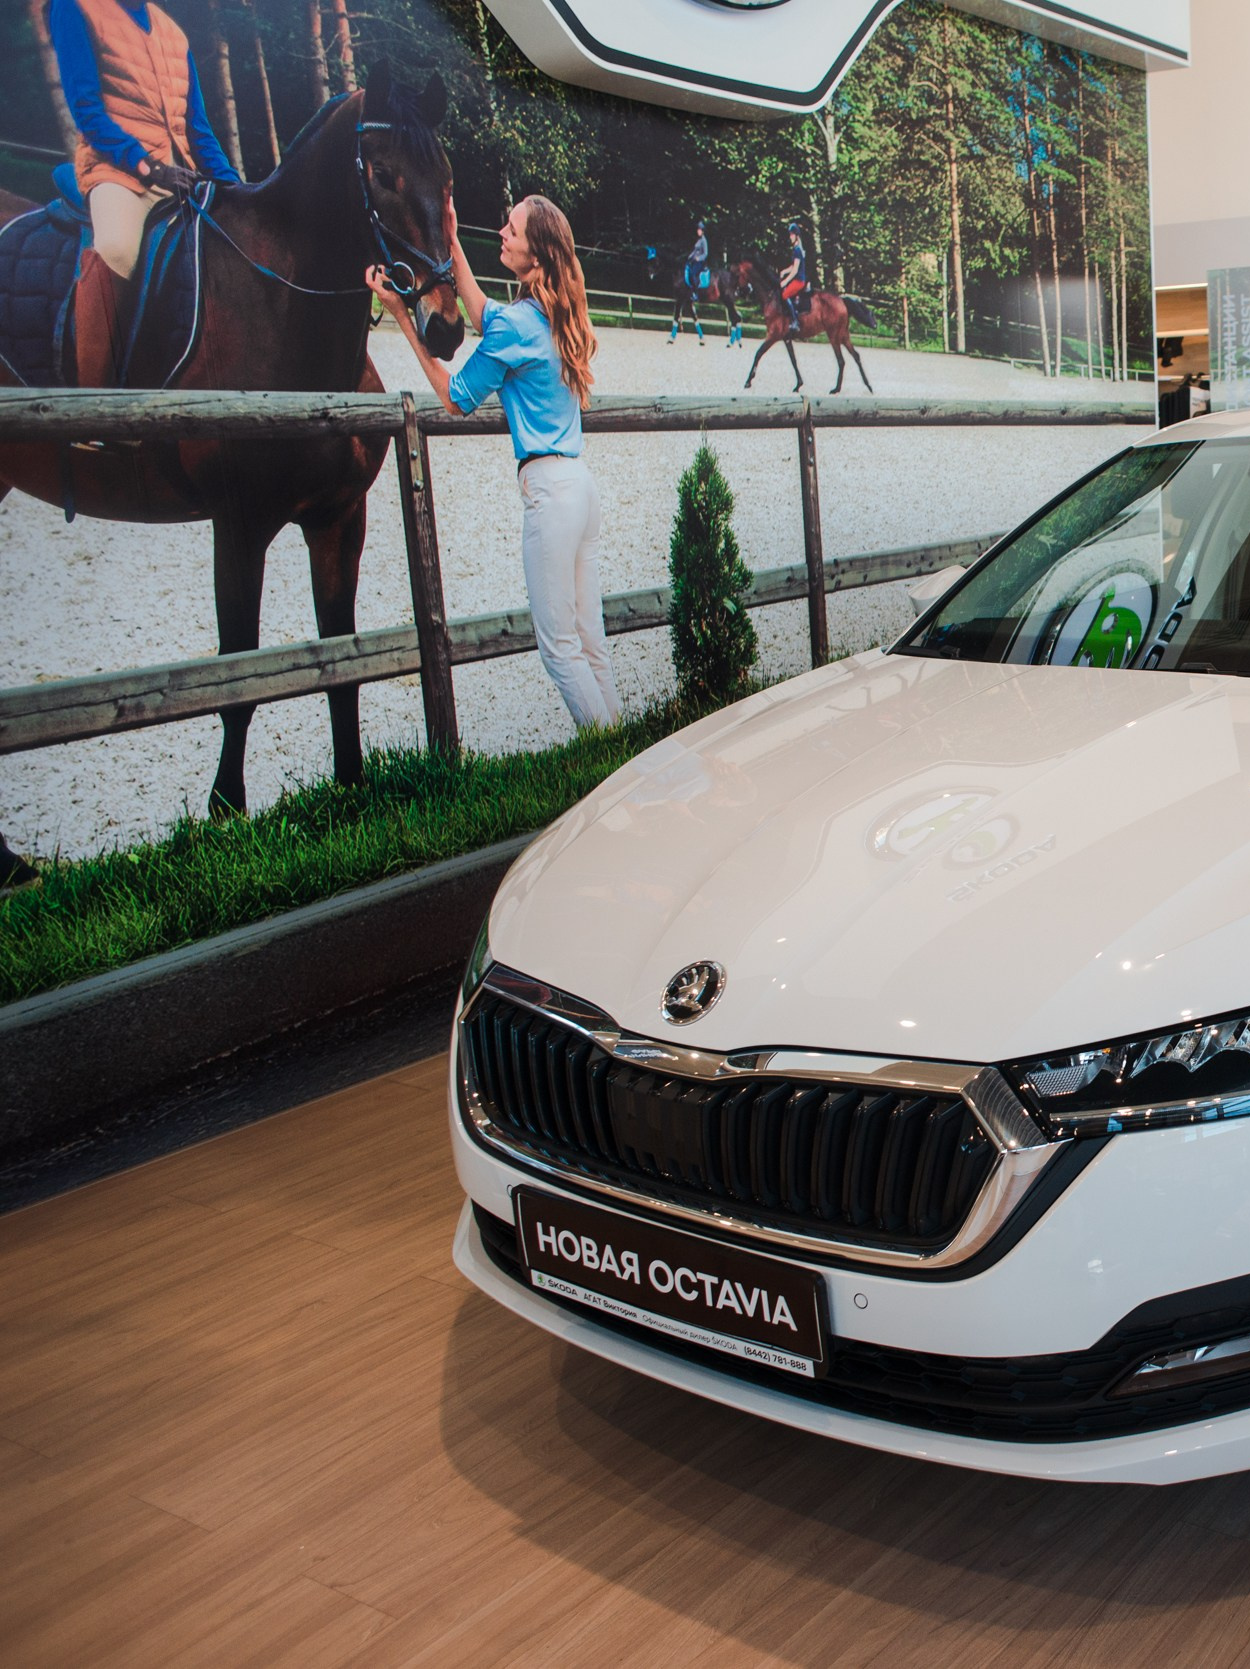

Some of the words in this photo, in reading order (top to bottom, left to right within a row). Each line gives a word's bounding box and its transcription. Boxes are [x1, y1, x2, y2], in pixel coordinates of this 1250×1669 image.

[535, 1221, 641, 1285] НОВАЯ
[647, 1258, 798, 1332] OCTAVIA
[583, 1292, 602, 1306] АГАТ
[603, 1299, 638, 1319] Виктория
[642, 1314, 689, 1336] Официальный
[690, 1330, 711, 1344] дилер
[744, 1345, 771, 1362] (8442)
[772, 1354, 807, 1371] 781-888
